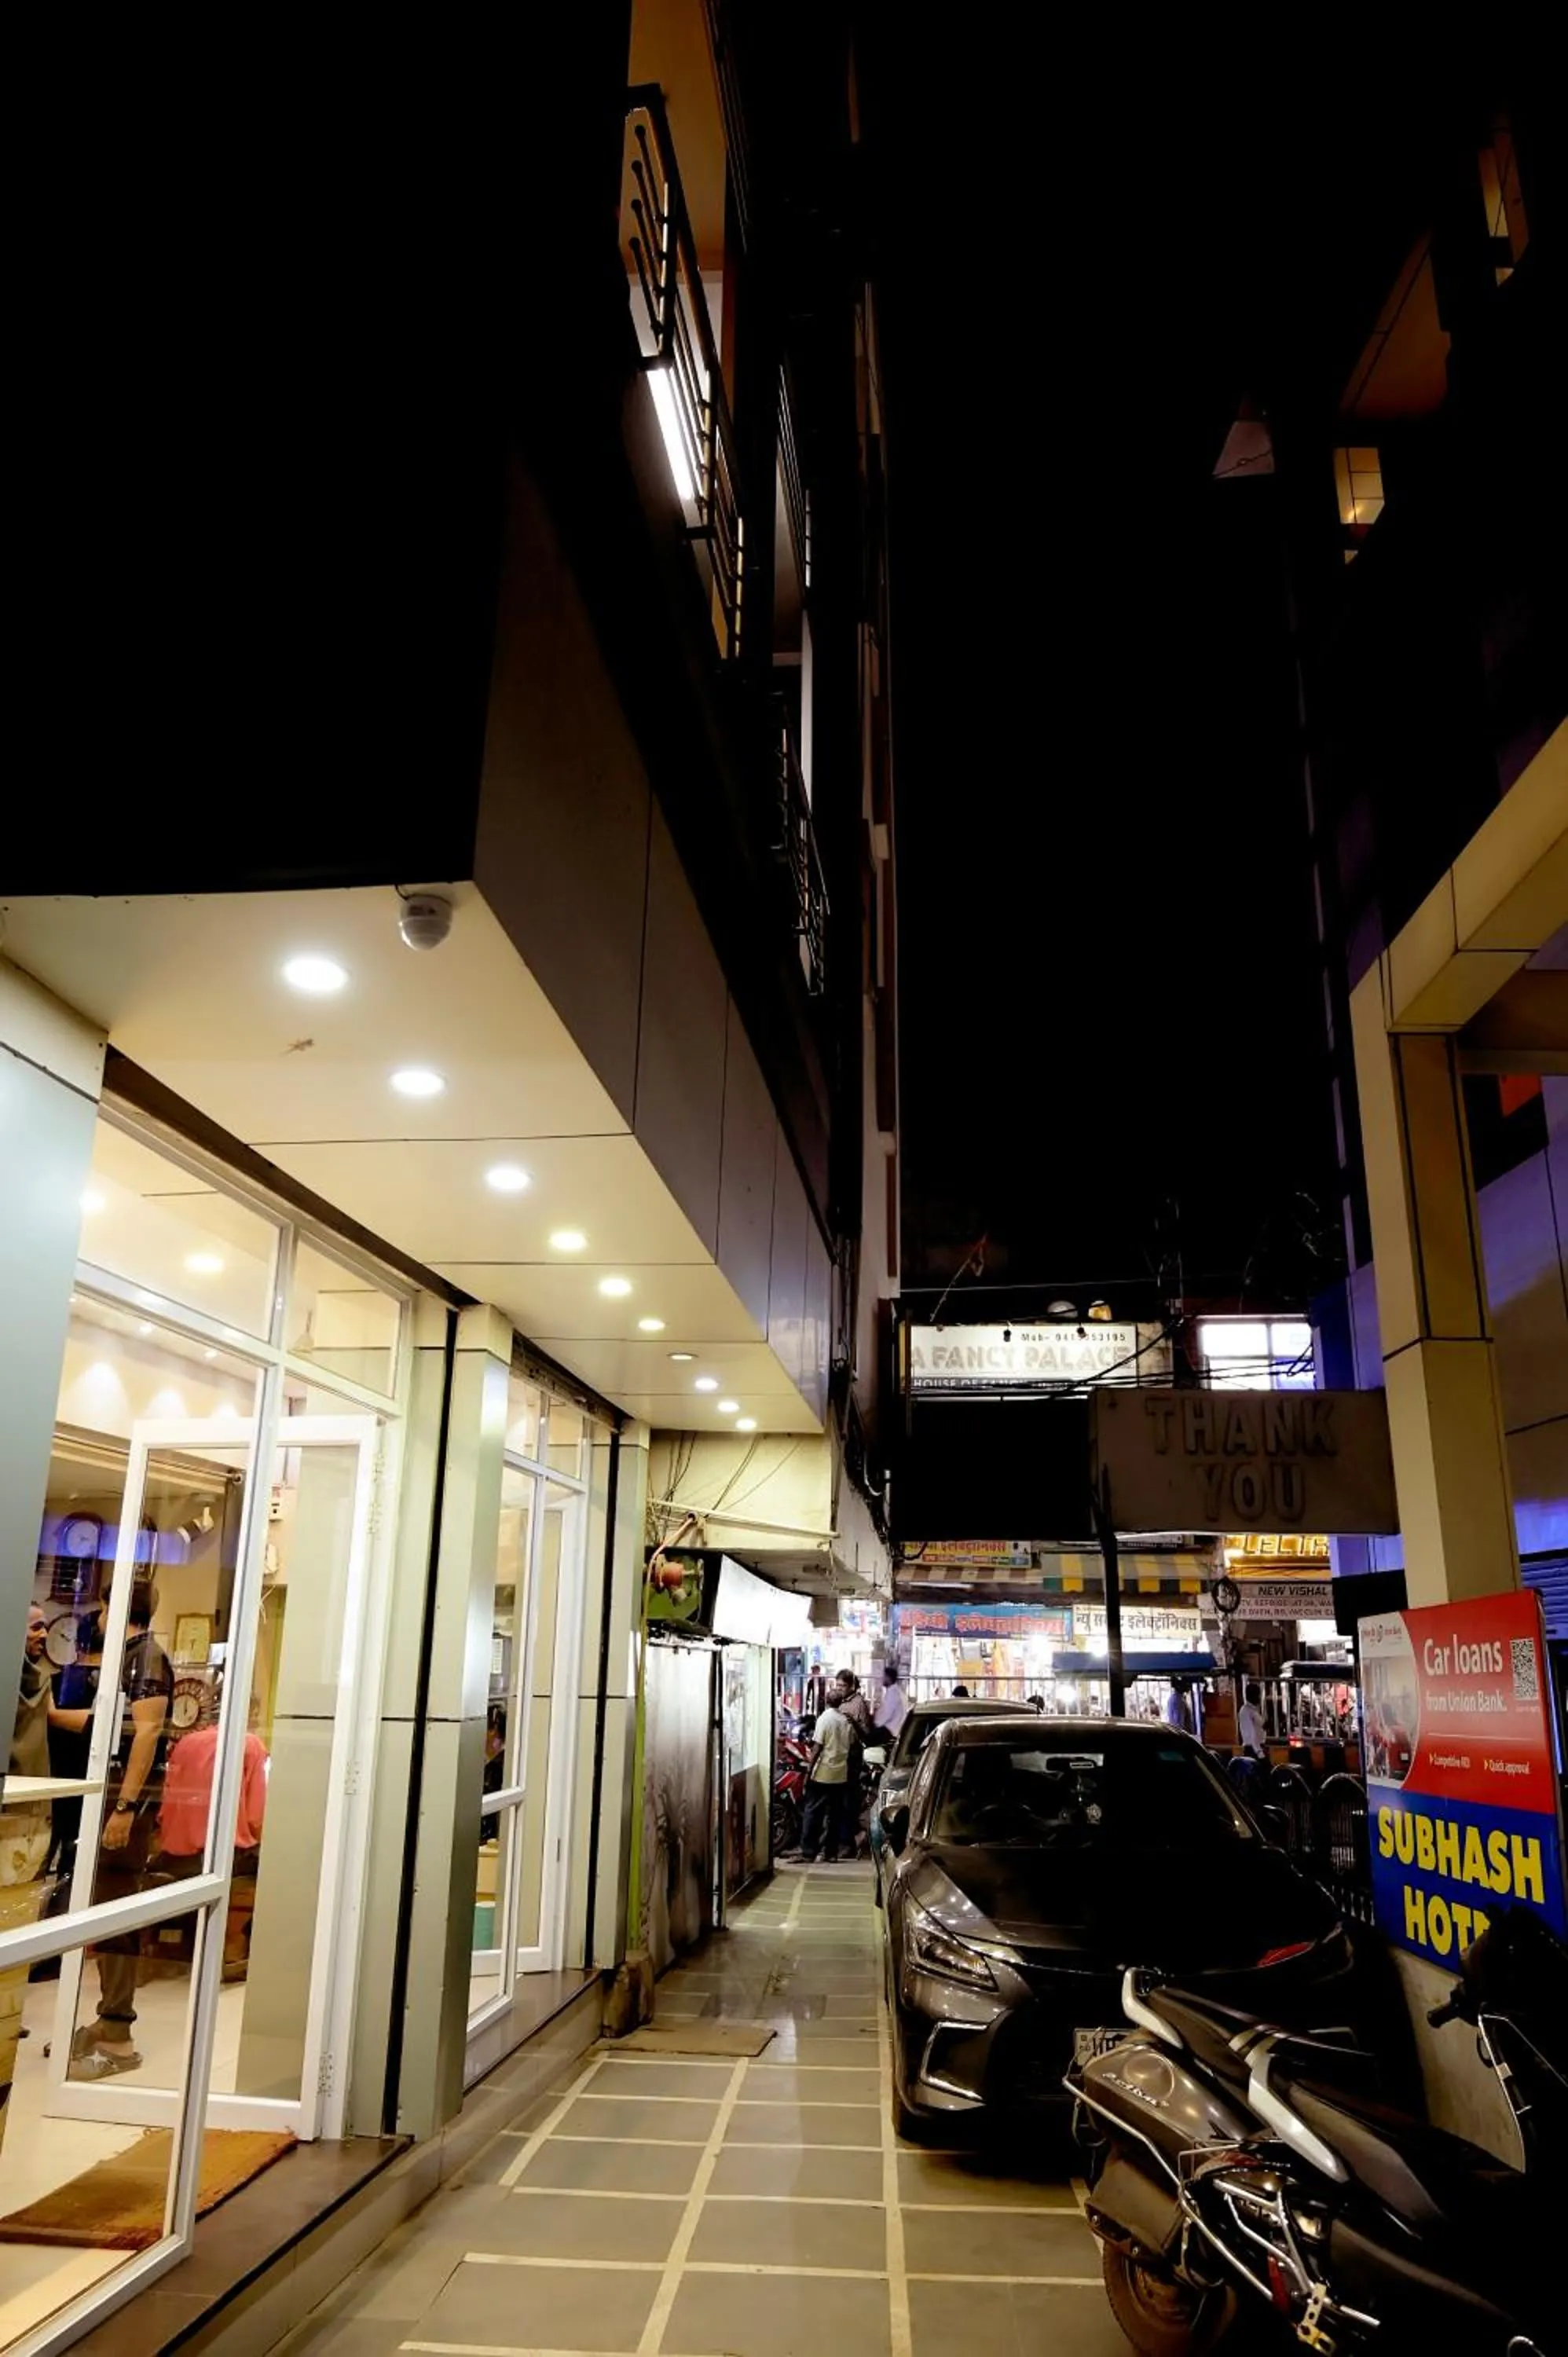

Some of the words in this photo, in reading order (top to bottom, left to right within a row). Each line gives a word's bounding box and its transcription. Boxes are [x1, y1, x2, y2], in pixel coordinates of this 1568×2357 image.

[932, 1346, 1015, 1369] FANCY
[1024, 1346, 1133, 1370] PALACE
[913, 1378, 957, 1387] HOUSE
[1145, 1395, 1338, 1457] THANK
[1192, 1461, 1306, 1523] YOU
[1258, 1585, 1287, 1596] NEW
[1424, 1637, 1450, 1675] Car
[1453, 1634, 1503, 1674] loans
[1426, 1689, 1446, 1711] from
[1447, 1689, 1476, 1711] Union
[1477, 1689, 1507, 1711] Bank.
[1489, 1759, 1504, 1773] Quick
[1504, 1761, 1530, 1777] approval
[1378, 1805, 1544, 1904] SUBHASH
